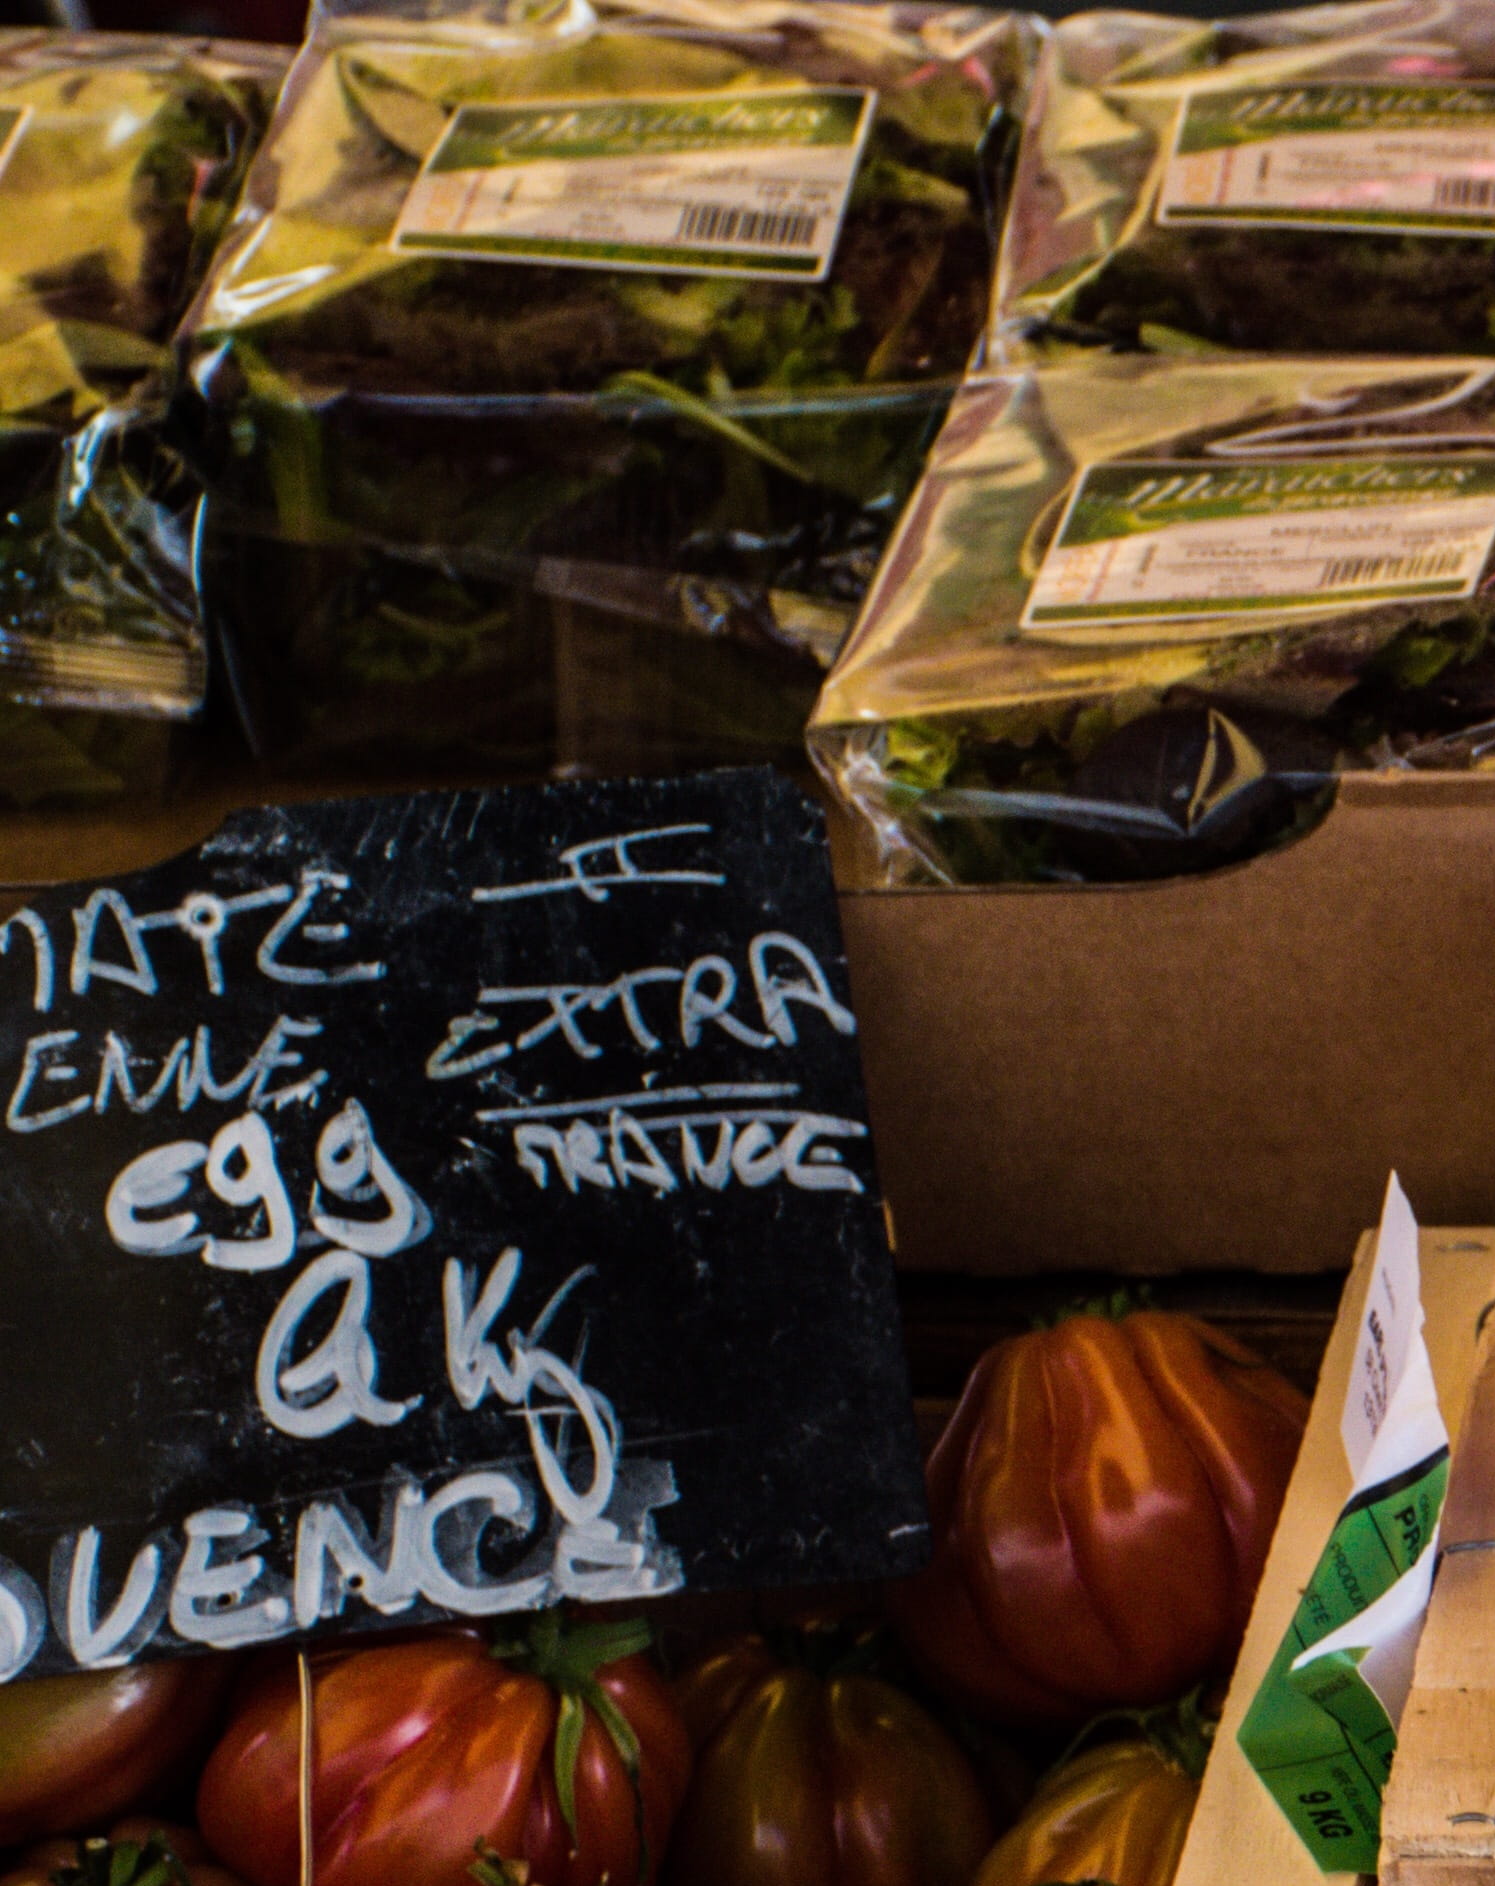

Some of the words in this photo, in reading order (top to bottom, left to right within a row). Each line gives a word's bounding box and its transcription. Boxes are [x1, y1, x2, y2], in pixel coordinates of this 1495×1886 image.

[425, 930, 858, 1080] EXTRA
[1299, 1790, 1331, 1805] 9
[1307, 1808, 1353, 1839] KG
